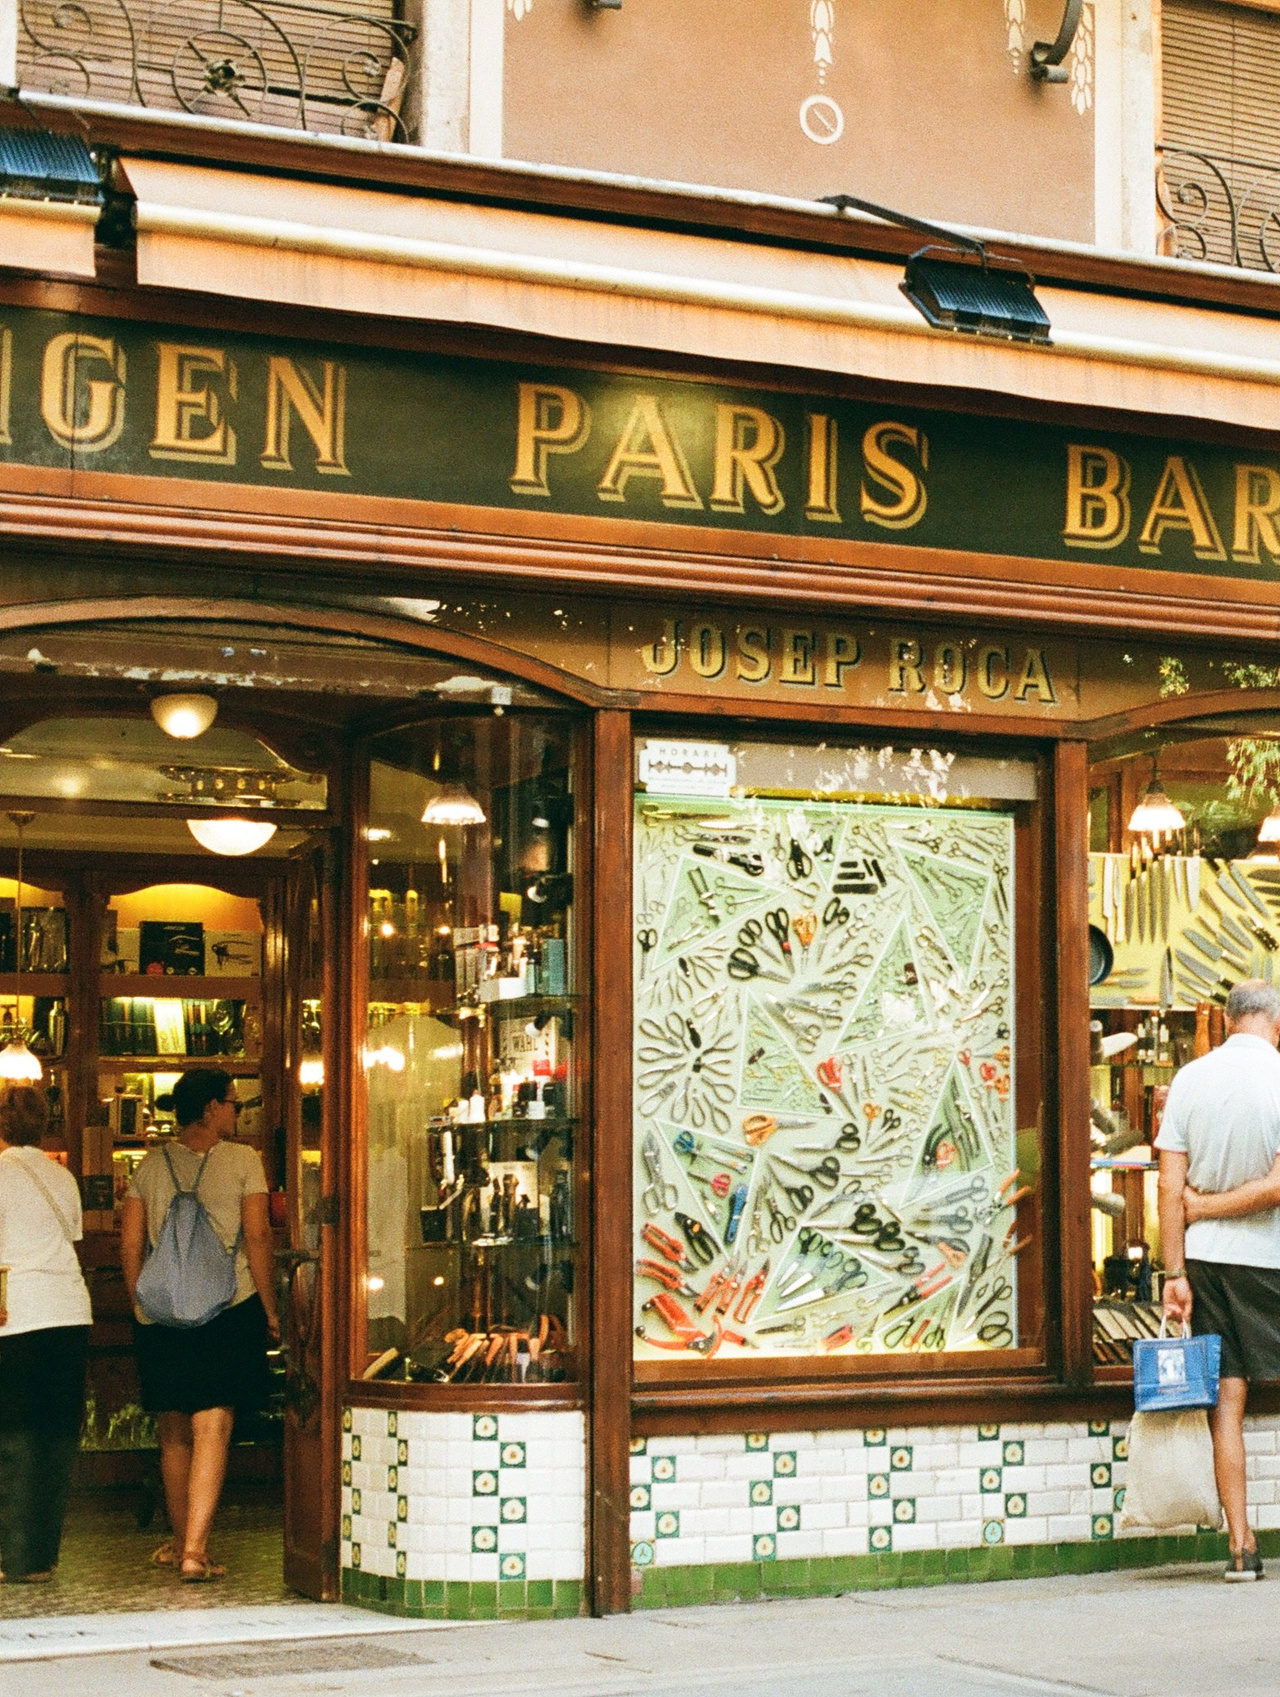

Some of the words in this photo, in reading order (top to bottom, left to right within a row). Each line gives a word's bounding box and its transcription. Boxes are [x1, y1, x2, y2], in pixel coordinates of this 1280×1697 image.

[0, 327, 350, 476] GEN
[510, 381, 929, 529] PARIS
[640, 616, 861, 690] JOSEP
[887, 632, 1058, 703] ROCA
[658, 747, 718, 758] HORARI
